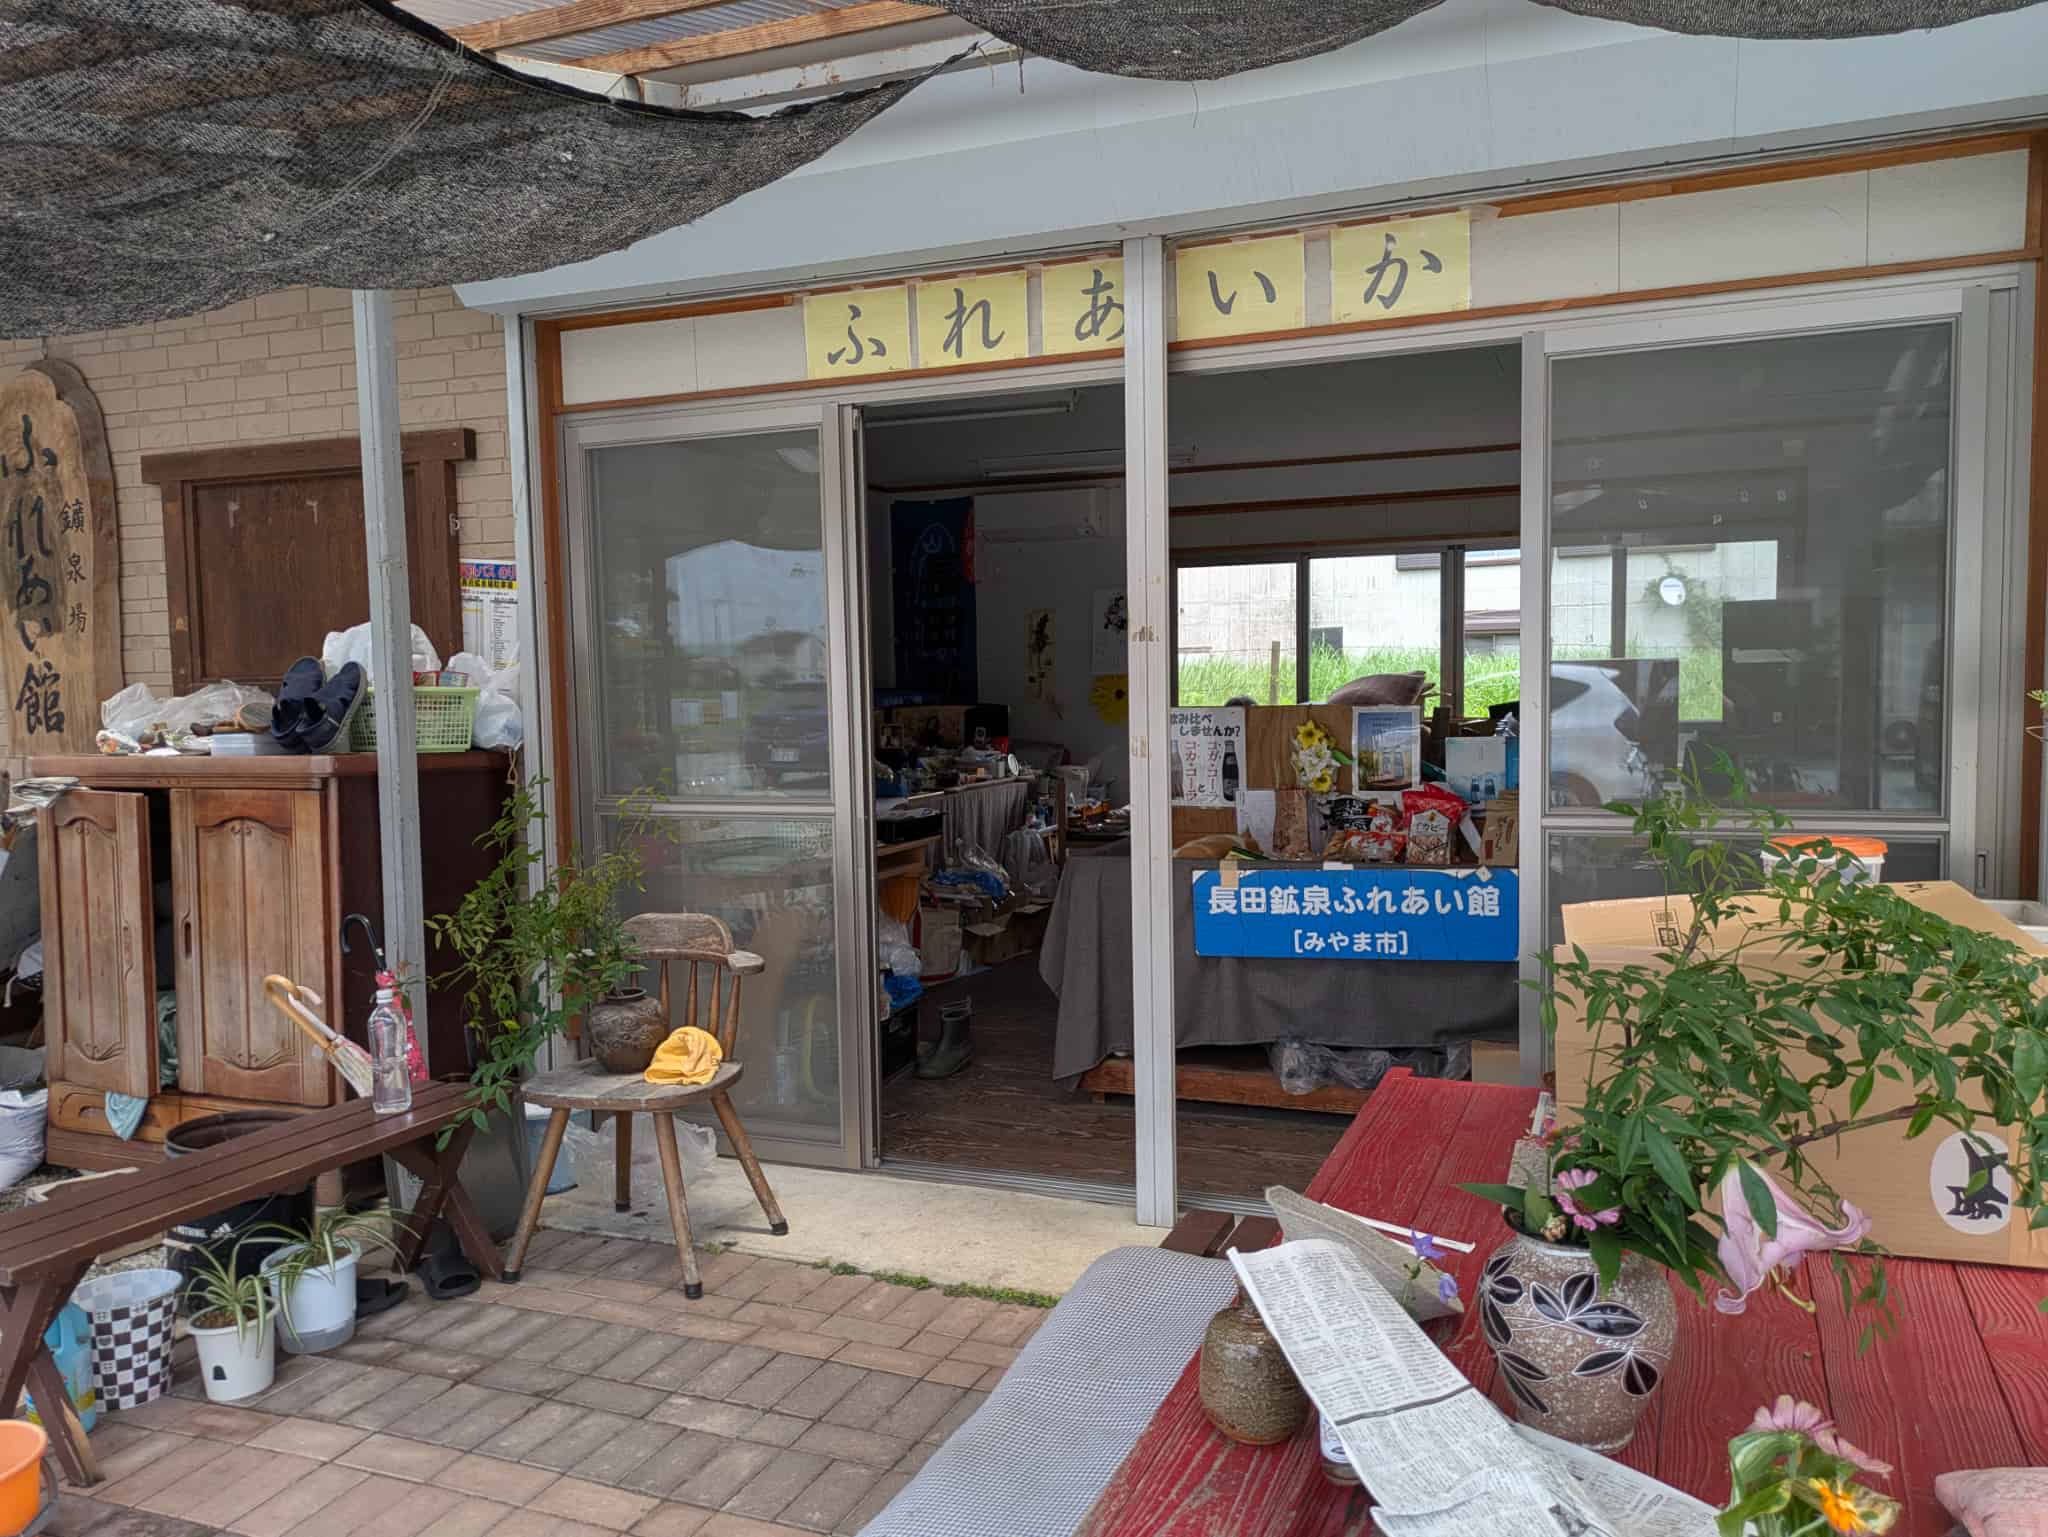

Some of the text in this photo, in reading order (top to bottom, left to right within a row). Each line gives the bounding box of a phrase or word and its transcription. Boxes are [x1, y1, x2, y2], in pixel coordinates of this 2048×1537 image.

[1208, 885, 1500, 917] 長田鉱泉ふれあい館
